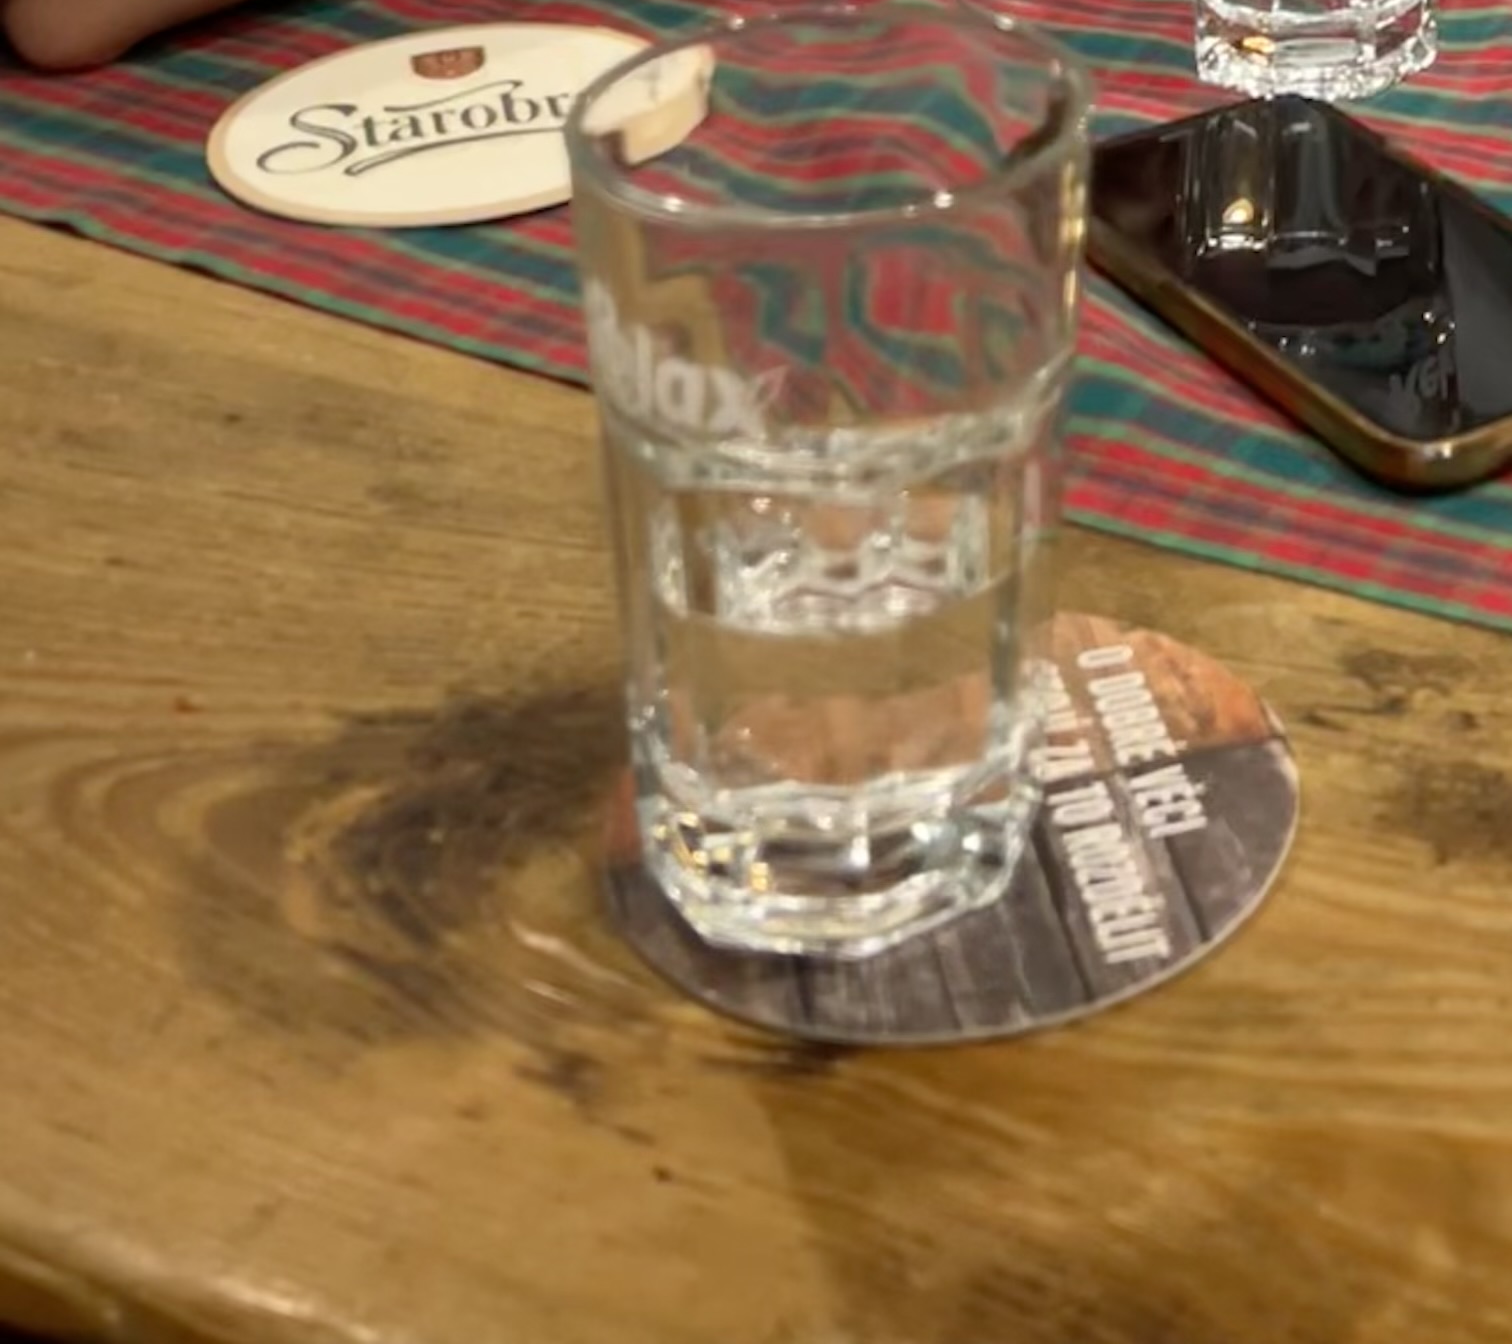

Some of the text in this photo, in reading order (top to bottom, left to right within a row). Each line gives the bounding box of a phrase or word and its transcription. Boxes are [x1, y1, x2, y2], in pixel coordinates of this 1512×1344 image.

[256, 80, 570, 174] Starobr
[1046, 780, 1115, 827] TO
[1129, 763, 1210, 839] VĚCI
[1062, 822, 1171, 965] ROZDĚLIT
